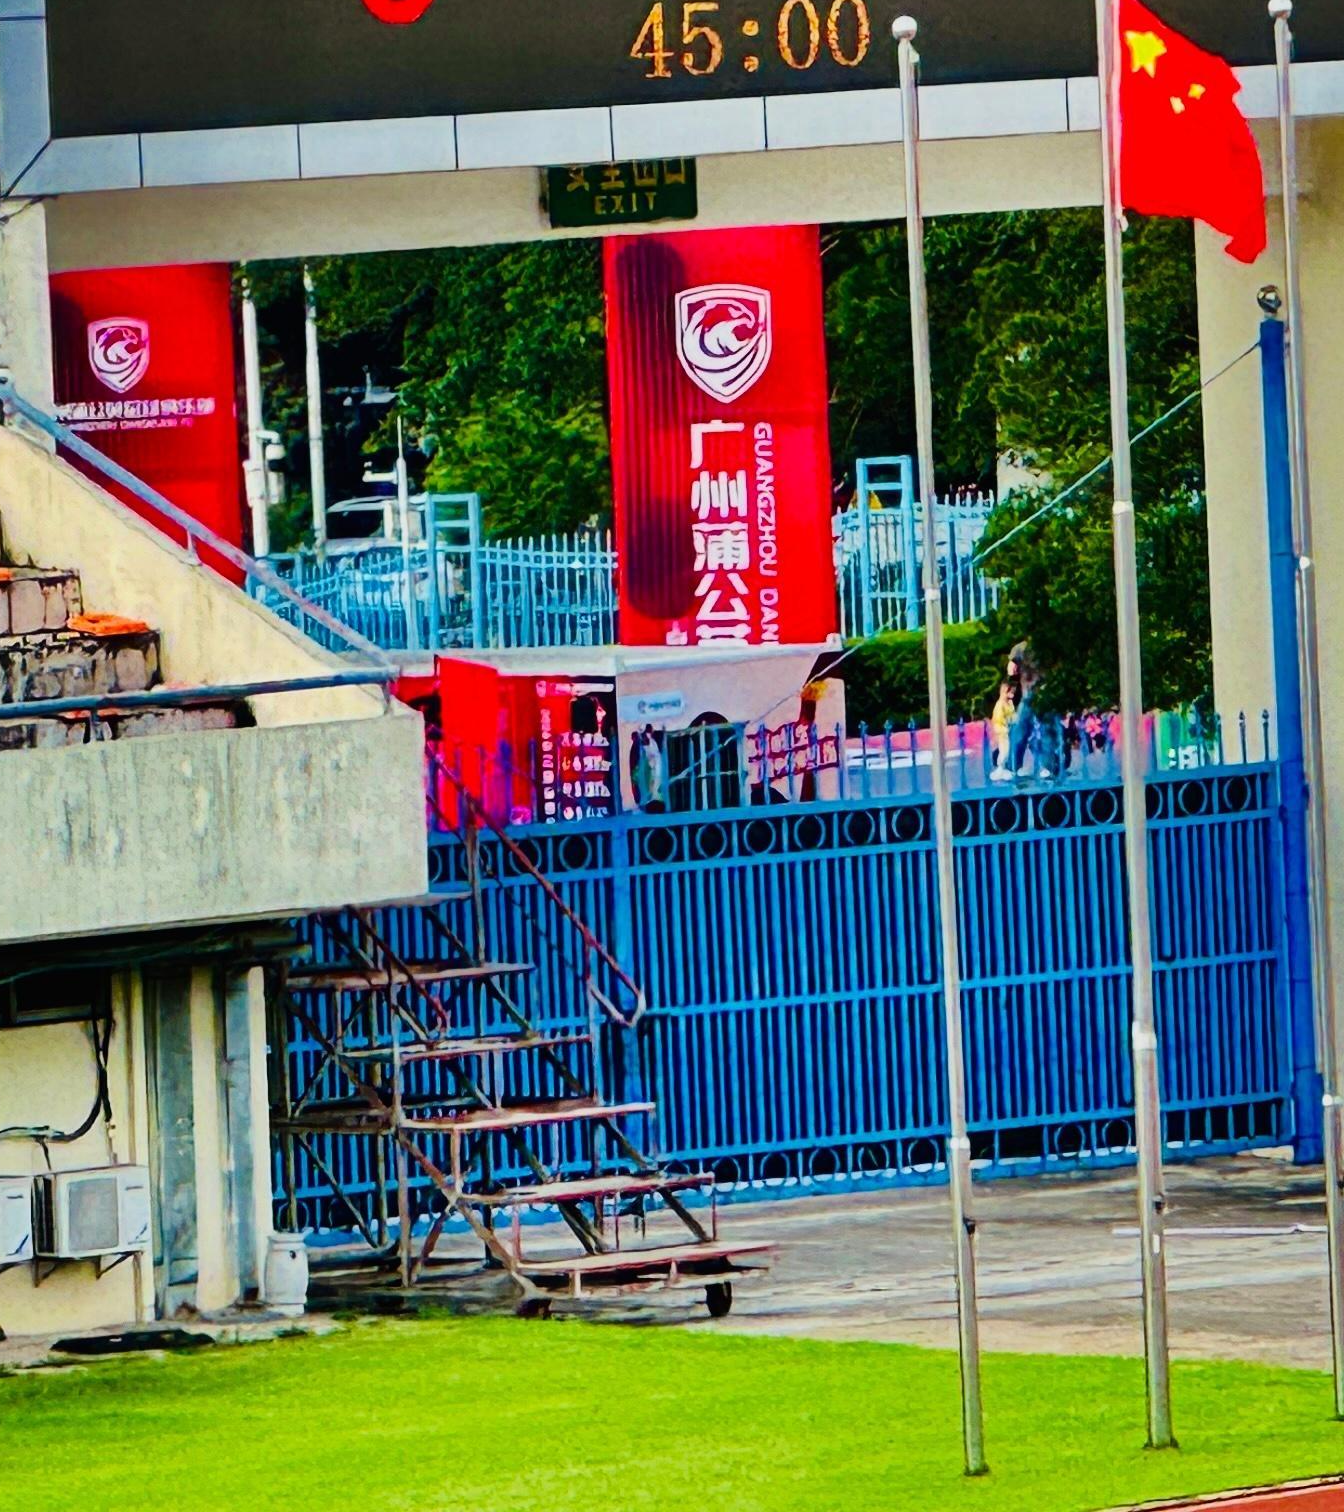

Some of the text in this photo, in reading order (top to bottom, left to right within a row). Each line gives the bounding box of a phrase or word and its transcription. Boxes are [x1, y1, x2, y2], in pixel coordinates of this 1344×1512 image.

[594, 191, 657, 215] EXIT
[753, 421, 780, 645] GUANGZHOU DAN
